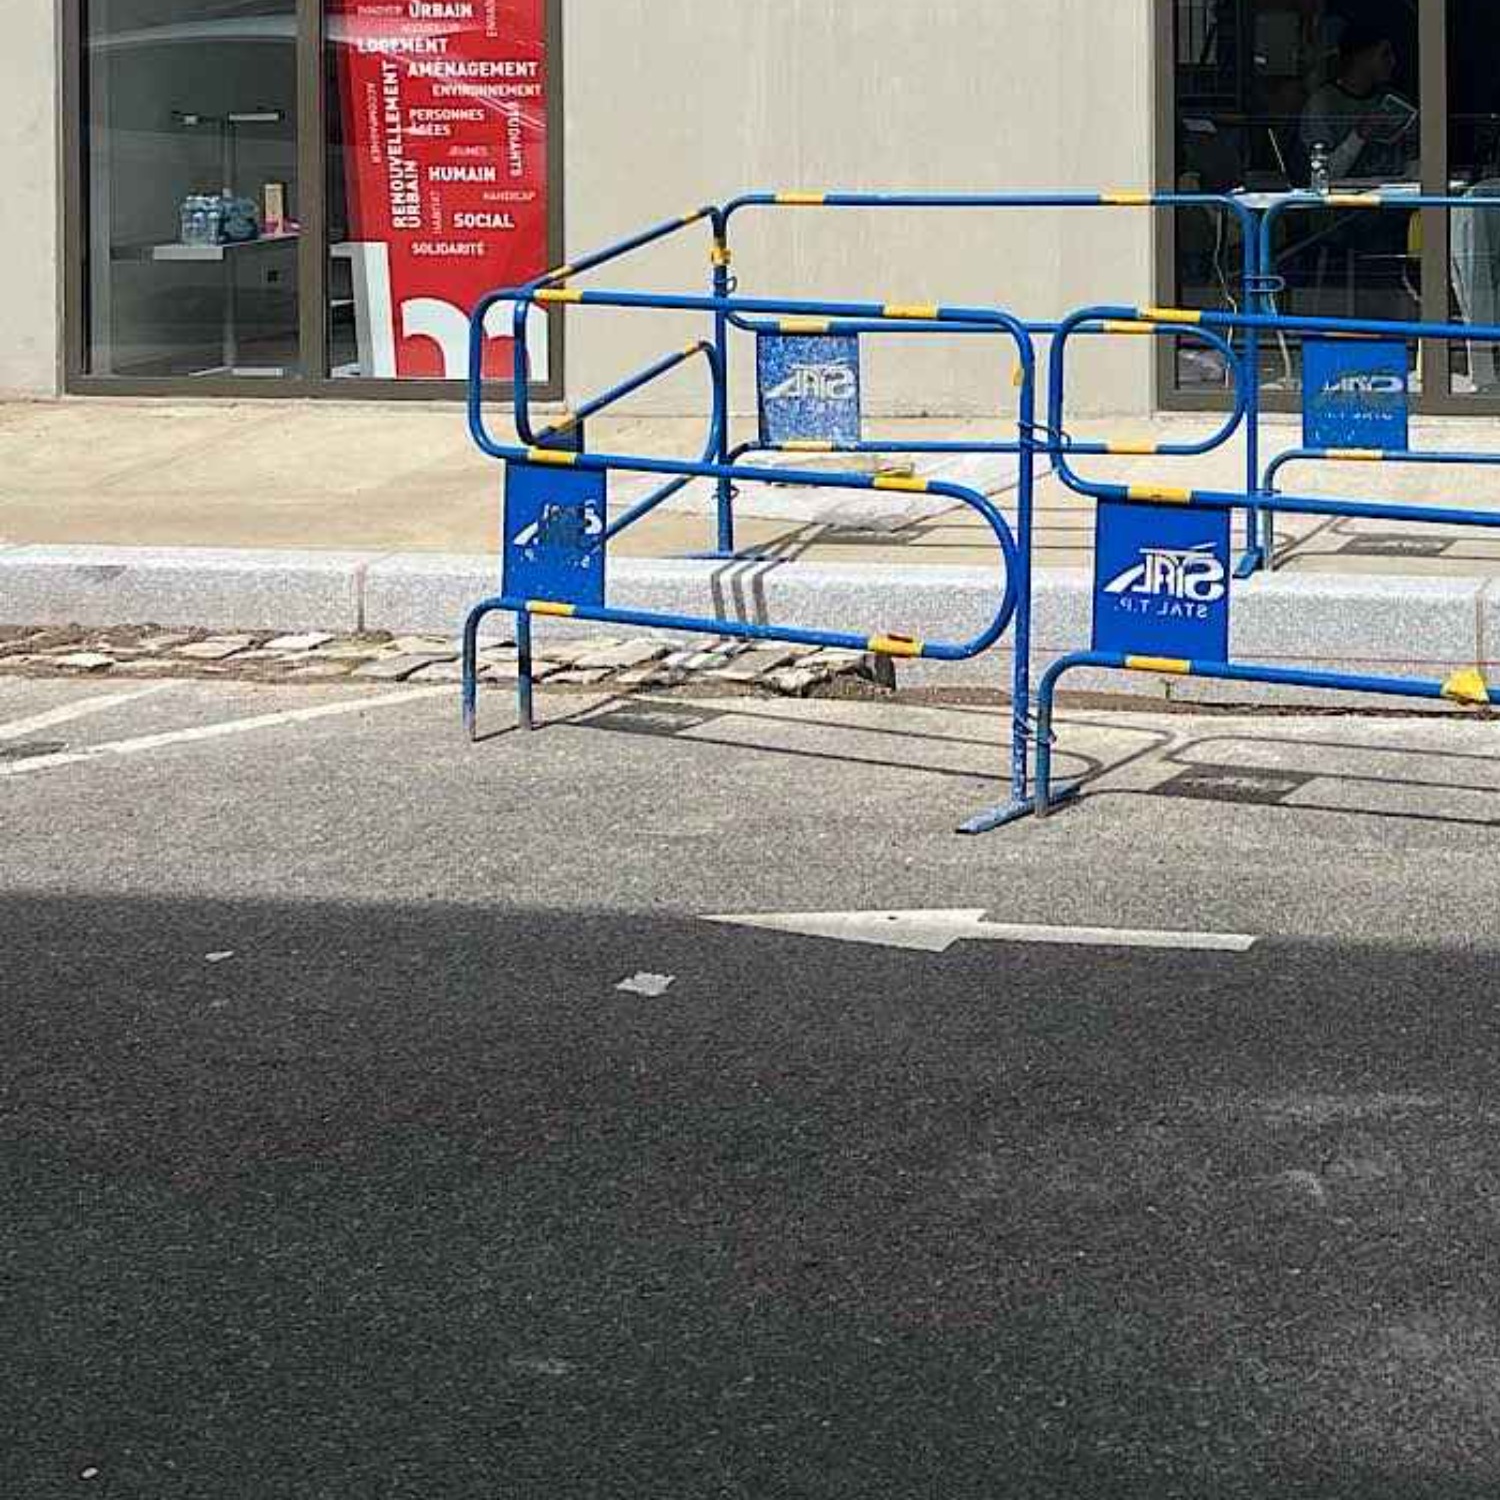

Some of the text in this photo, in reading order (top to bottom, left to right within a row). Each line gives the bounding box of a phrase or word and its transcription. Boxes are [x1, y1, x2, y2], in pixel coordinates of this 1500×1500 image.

[409, 2, 472, 18] URBAIN
[357, 38, 447, 53] LOGEMENT
[432, 84, 541, 97] ENVIRONNEMENT
[409, 109, 484, 121] PERSONNES
[382, 60, 408, 228] RENOUVELLEMENT
[428, 167, 496, 181] HUMAIN
[402, 160, 421, 228] URBAIN
[454, 213, 515, 228] SOCIAL
[411, 242, 484, 256] SOLIDARITÉ
